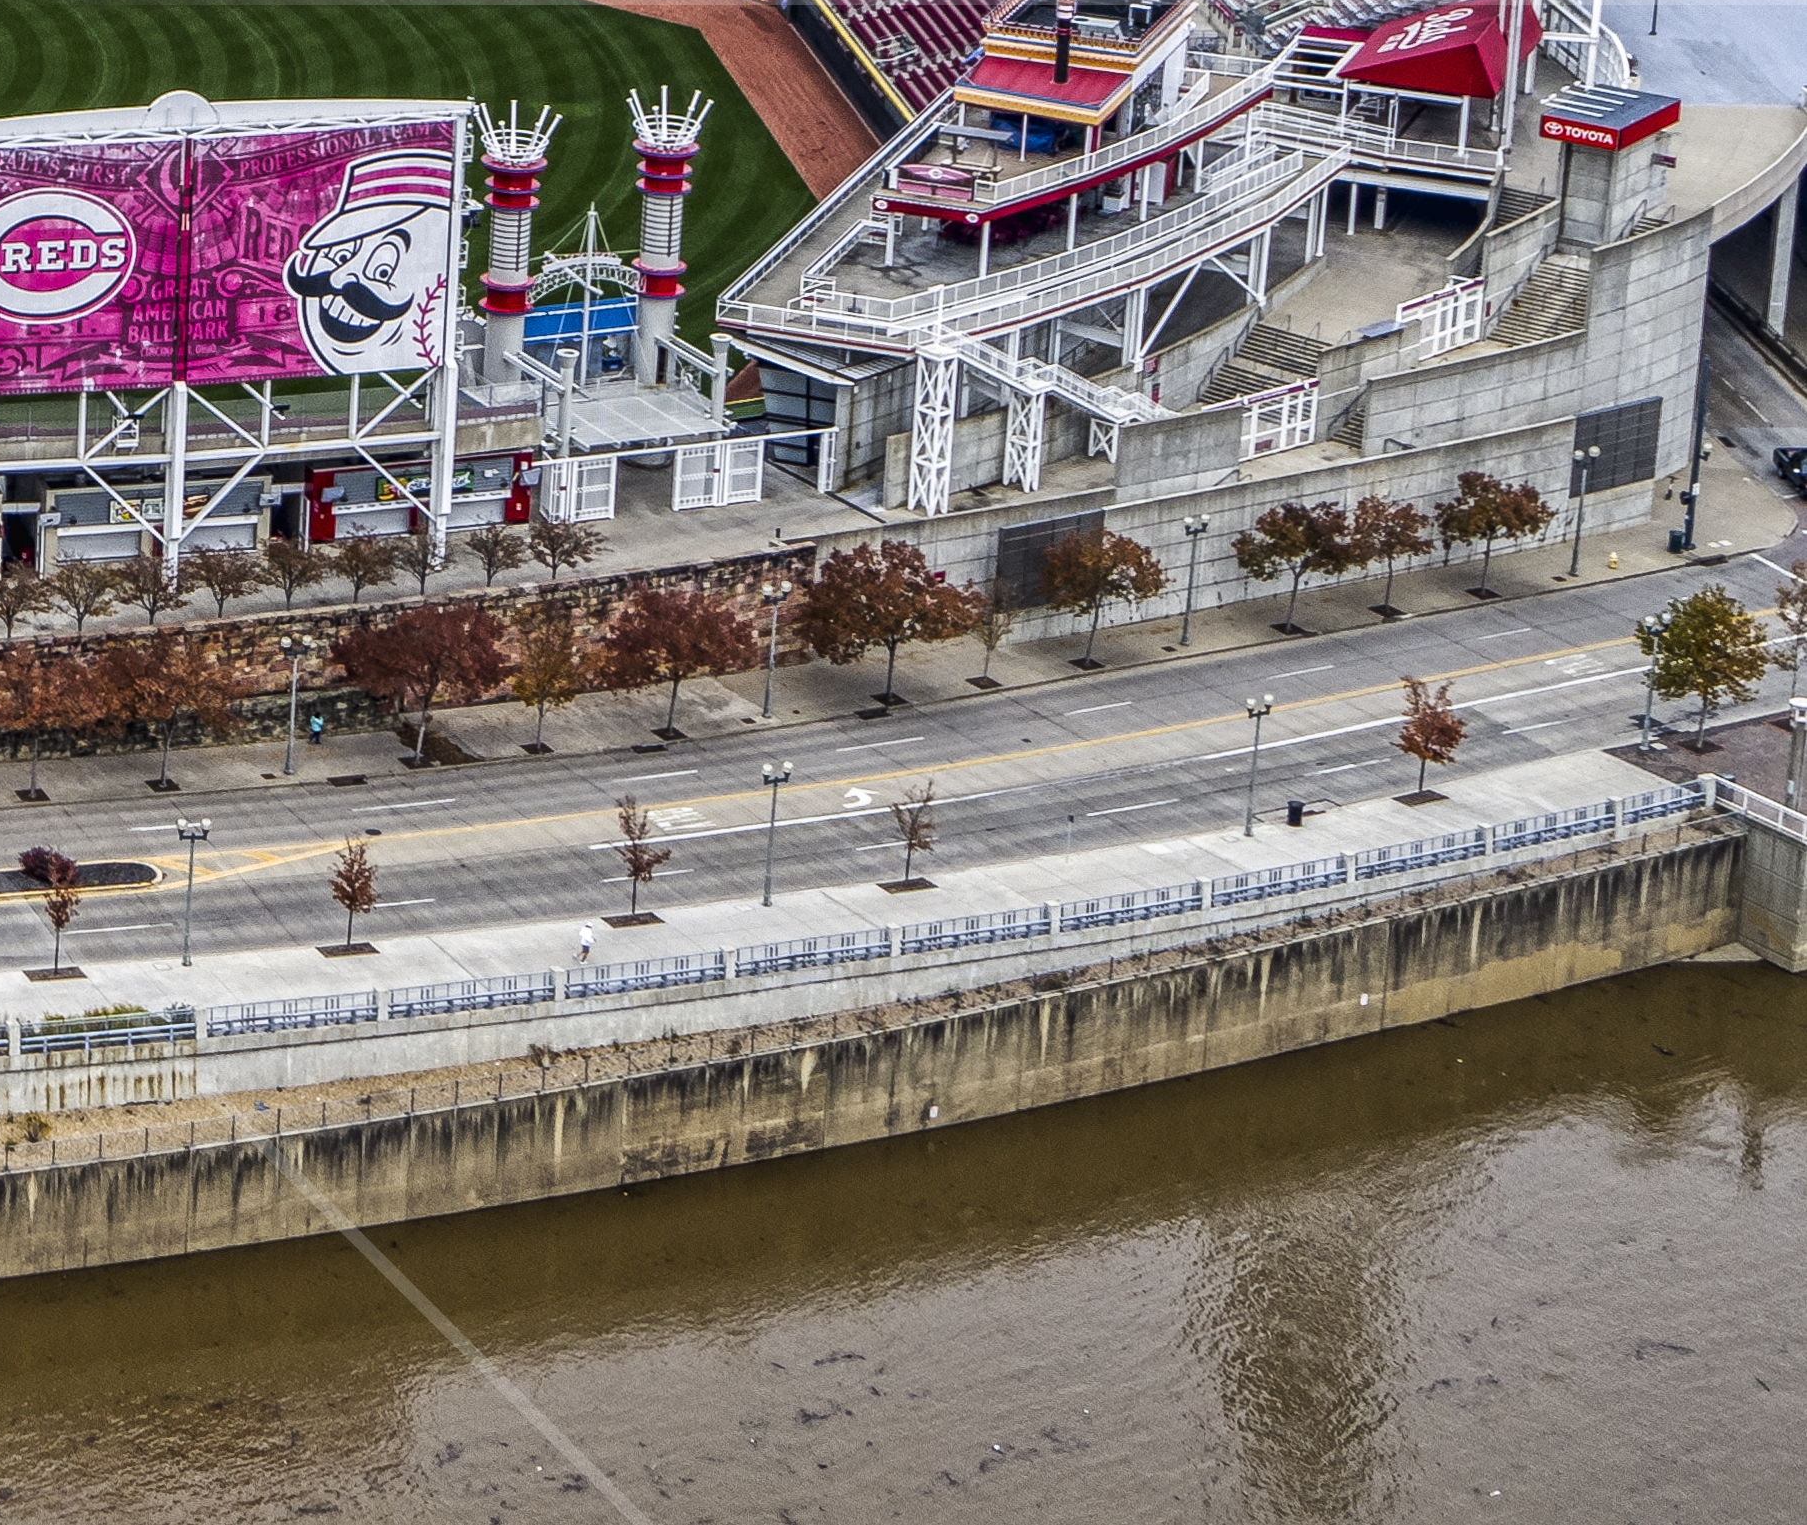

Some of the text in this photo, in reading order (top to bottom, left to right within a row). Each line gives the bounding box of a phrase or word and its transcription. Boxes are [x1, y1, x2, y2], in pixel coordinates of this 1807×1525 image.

[1565, 126, 1613, 144] TOYOTA
[239, 125, 431, 177] PROFESSIONAL TEAM
[69, 159, 131, 185] FIRST
[1, 239, 126, 274] REDS
[128, 320, 229, 344] BALL PARK
